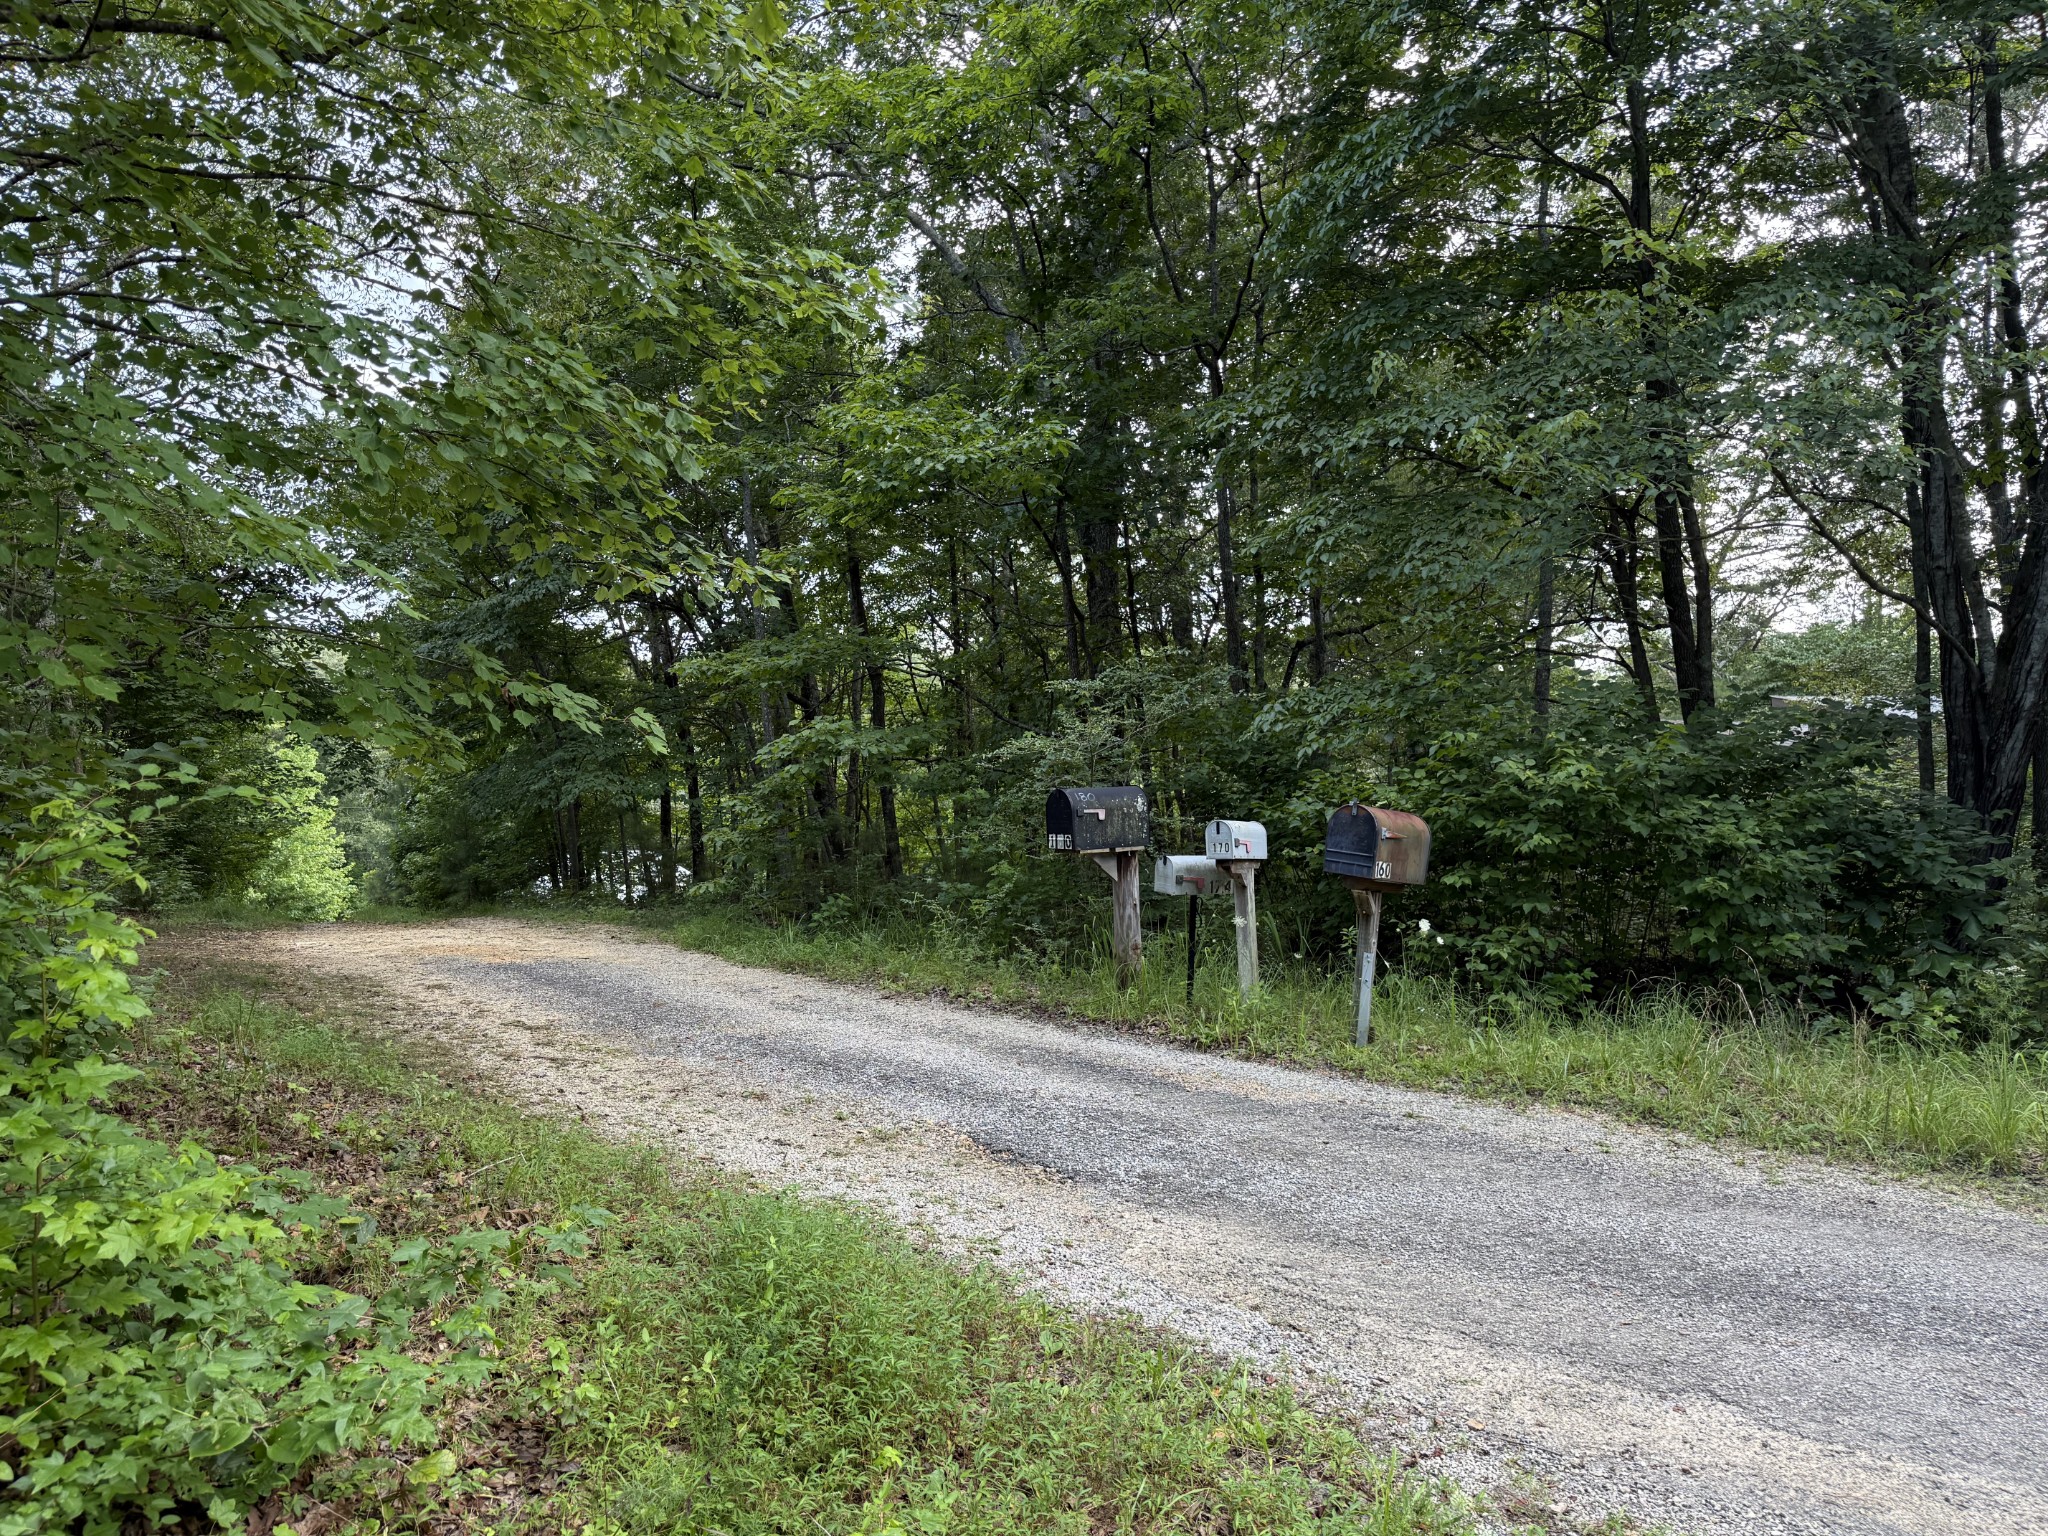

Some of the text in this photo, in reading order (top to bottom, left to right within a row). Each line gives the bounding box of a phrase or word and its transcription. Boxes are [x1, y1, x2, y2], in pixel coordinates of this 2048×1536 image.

[1074, 792, 1096, 801] 180
[1049, 834, 1072, 849] 10
[1212, 842, 1230, 853] 170
[1375, 861, 1391, 878] 160
